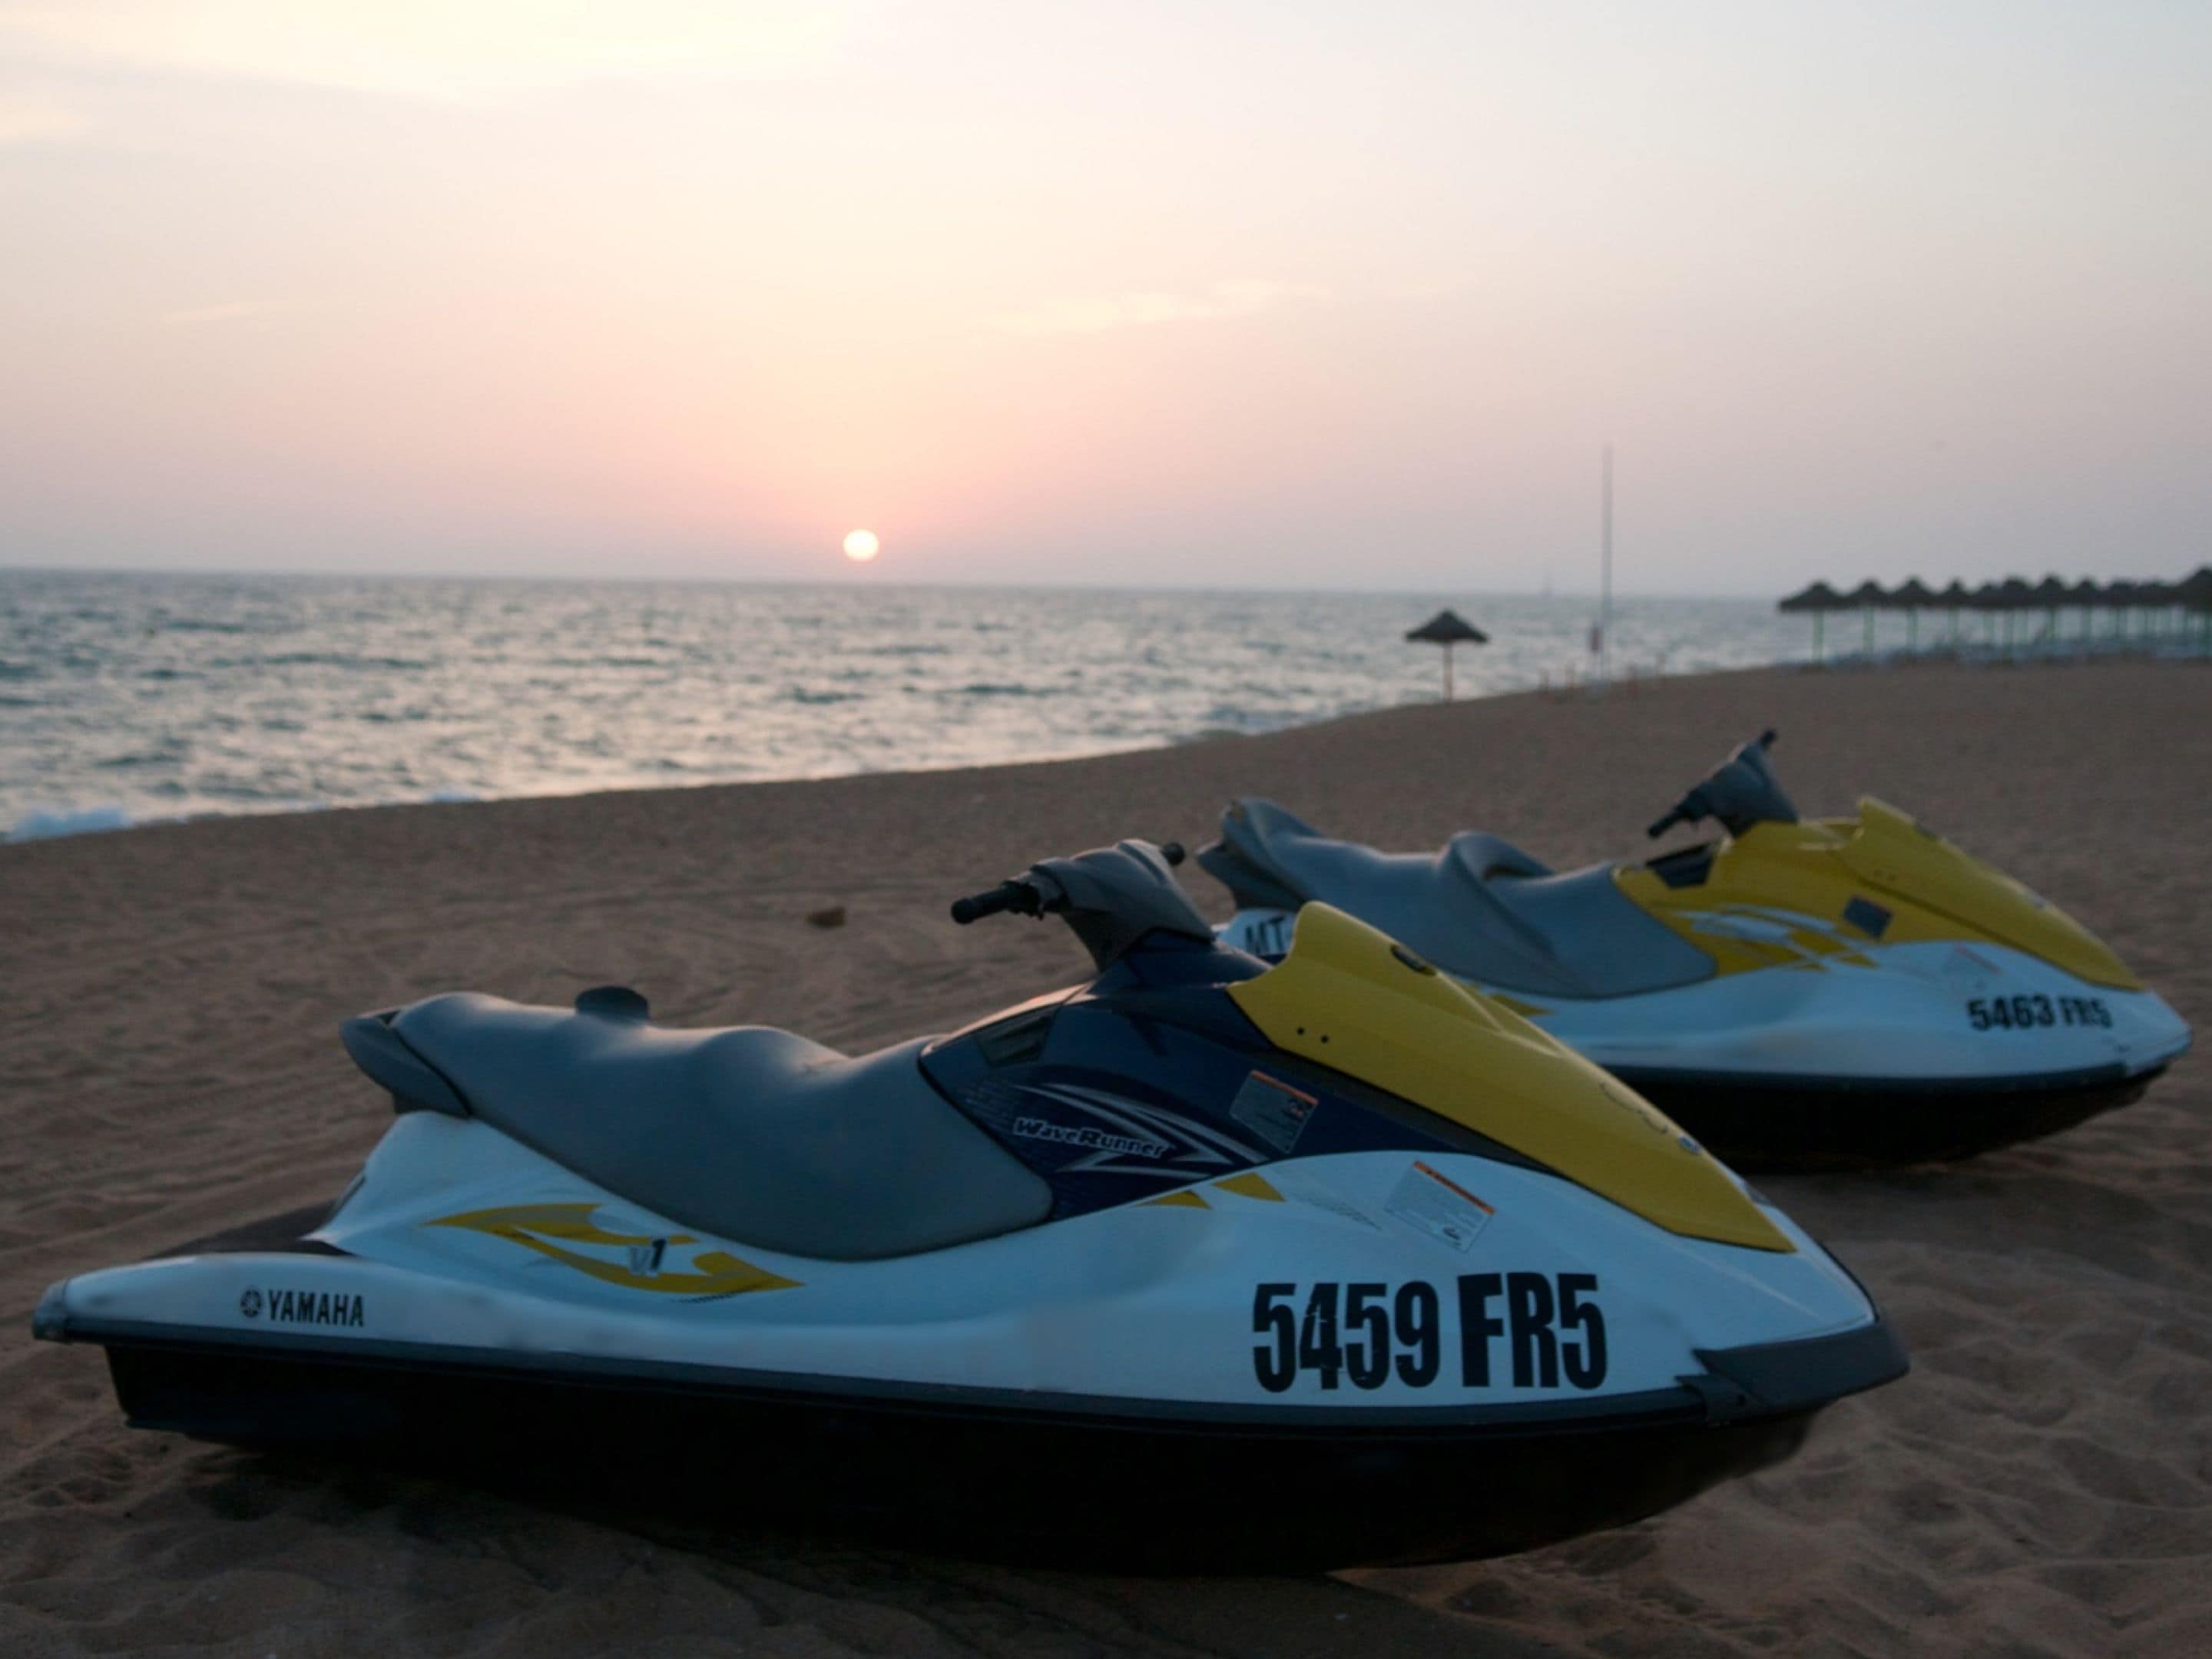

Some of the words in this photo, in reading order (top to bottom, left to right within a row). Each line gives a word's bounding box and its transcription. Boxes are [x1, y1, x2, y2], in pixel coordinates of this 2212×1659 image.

[1967, 995, 2055, 1030] 5463
[1014, 1118, 1169, 1158] WaveRunner
[268, 1290, 364, 1327] YAMAHA
[1253, 1281, 1440, 1392] 5459
[1457, 1272, 1608, 1389] FR5
